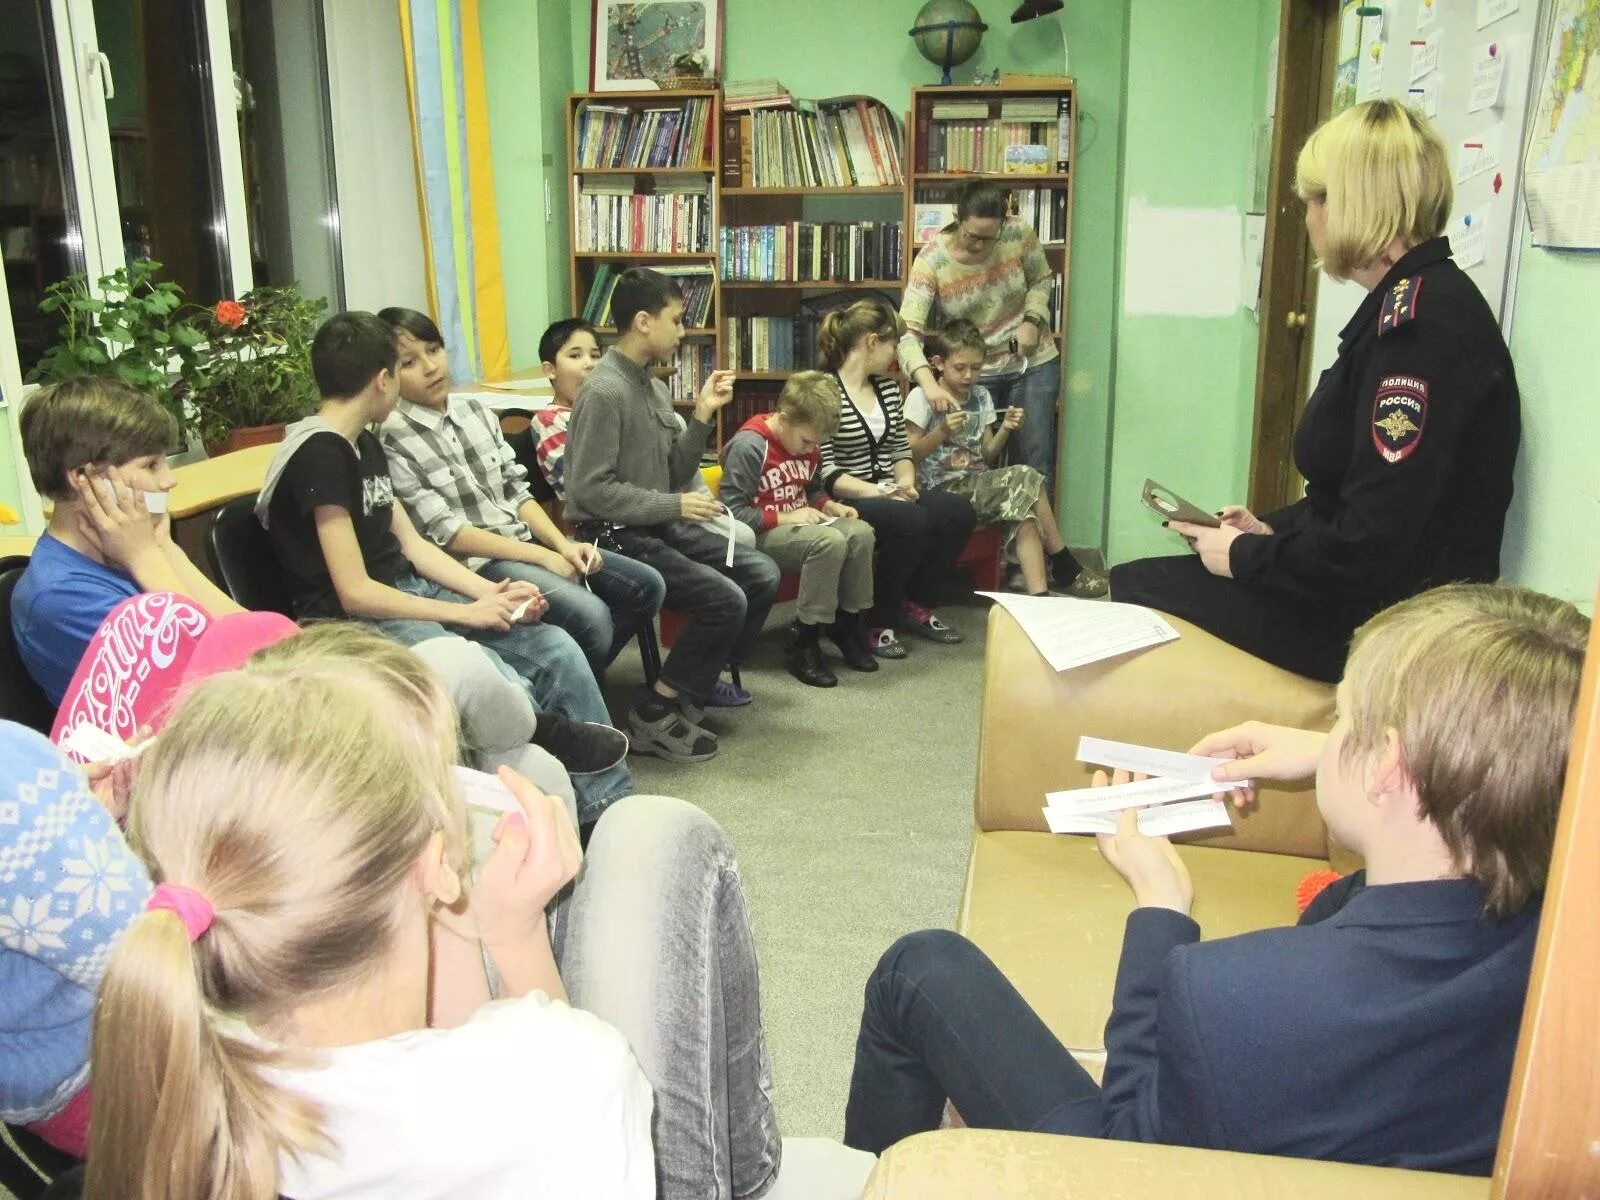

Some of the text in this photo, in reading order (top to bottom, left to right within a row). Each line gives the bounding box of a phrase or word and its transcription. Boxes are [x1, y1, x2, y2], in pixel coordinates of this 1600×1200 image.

[1381, 378, 1425, 392] ПОЛИЦИЯ
[1380, 396, 1421, 412] РОССИЯ
[1383, 448, 1402, 462] МВД
